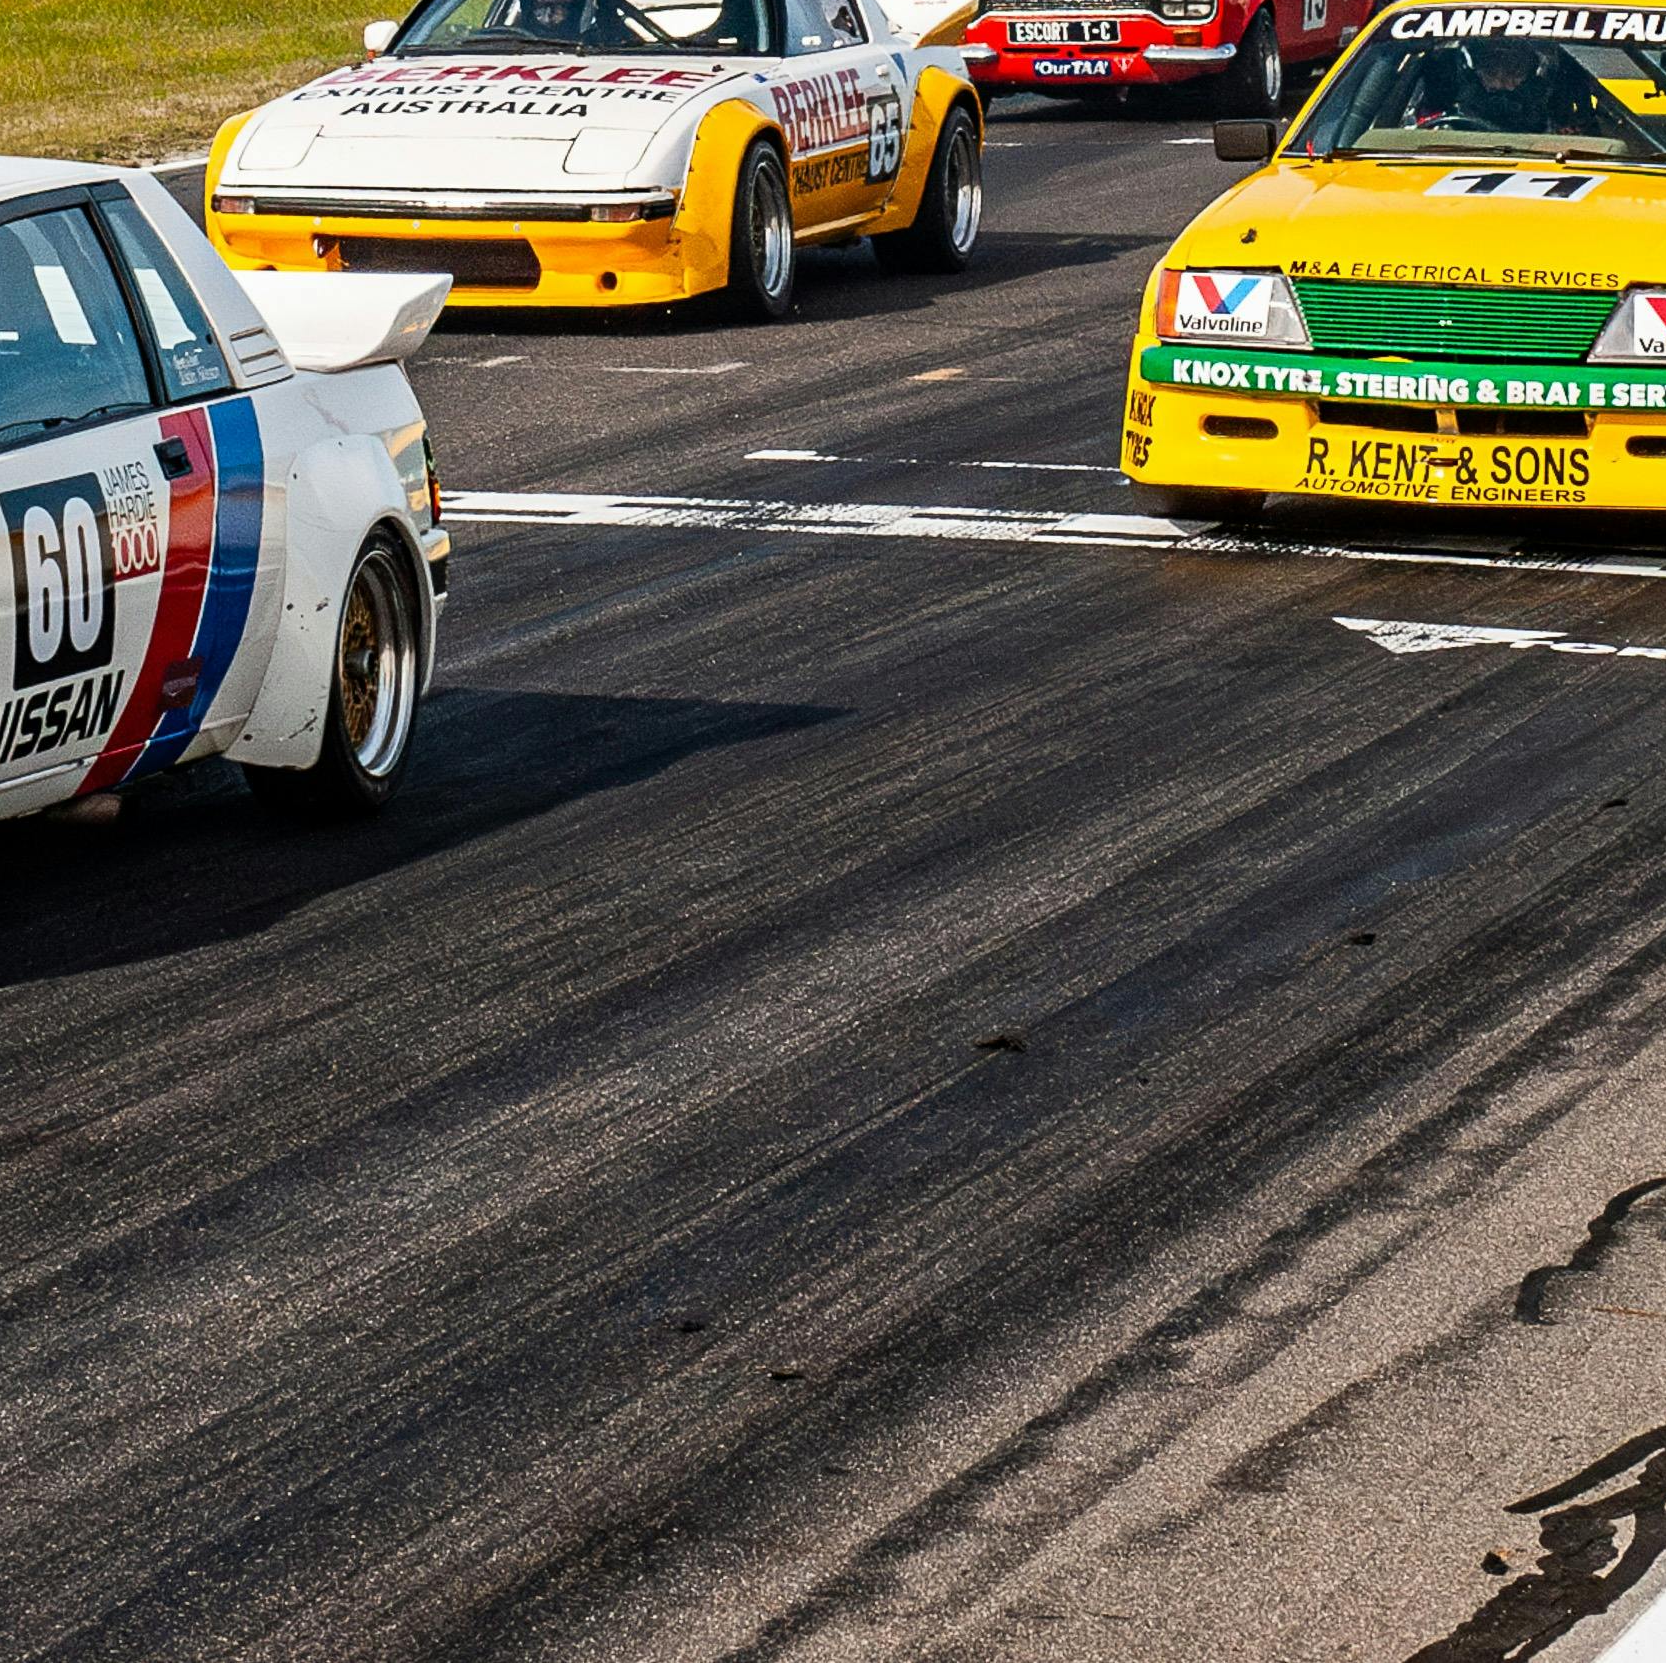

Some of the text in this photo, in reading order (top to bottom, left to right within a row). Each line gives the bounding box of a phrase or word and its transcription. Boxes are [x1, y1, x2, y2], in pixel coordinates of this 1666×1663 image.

[1014, 21, 1111, 42] ESCORT T-C
[1391, 9, 1596, 40] CAMPBELL
[319, 65, 717, 89] BERKLEE
[293, 84, 686, 104] EXHAUST CENTRE
[339, 100, 588, 117] AUSTRALIA
[770, 68, 869, 154] BERKLEE
[869, 102, 902, 178] 65
[1451, 172, 1594, 199] 11
[1351, 262, 1491, 283] ELECTRICAL
[1501, 268, 1620, 288] SERVICES
[1180, 313, 1263, 334] Valvoline
[1173, 358, 1251, 388] KNOX
[1335, 372, 1470, 403] STEERING
[1476, 378, 1501, 404] &
[1305, 436, 1590, 487] R. KENT & SONS
[103, 461, 150, 497] JAMES
[1295, 476, 1587, 503] AUTOMOTIVE ENGINEERS
[107, 491, 158, 529] HARDIE
[111, 523, 160, 577] 1000
[22, 496, 106, 663] 60
